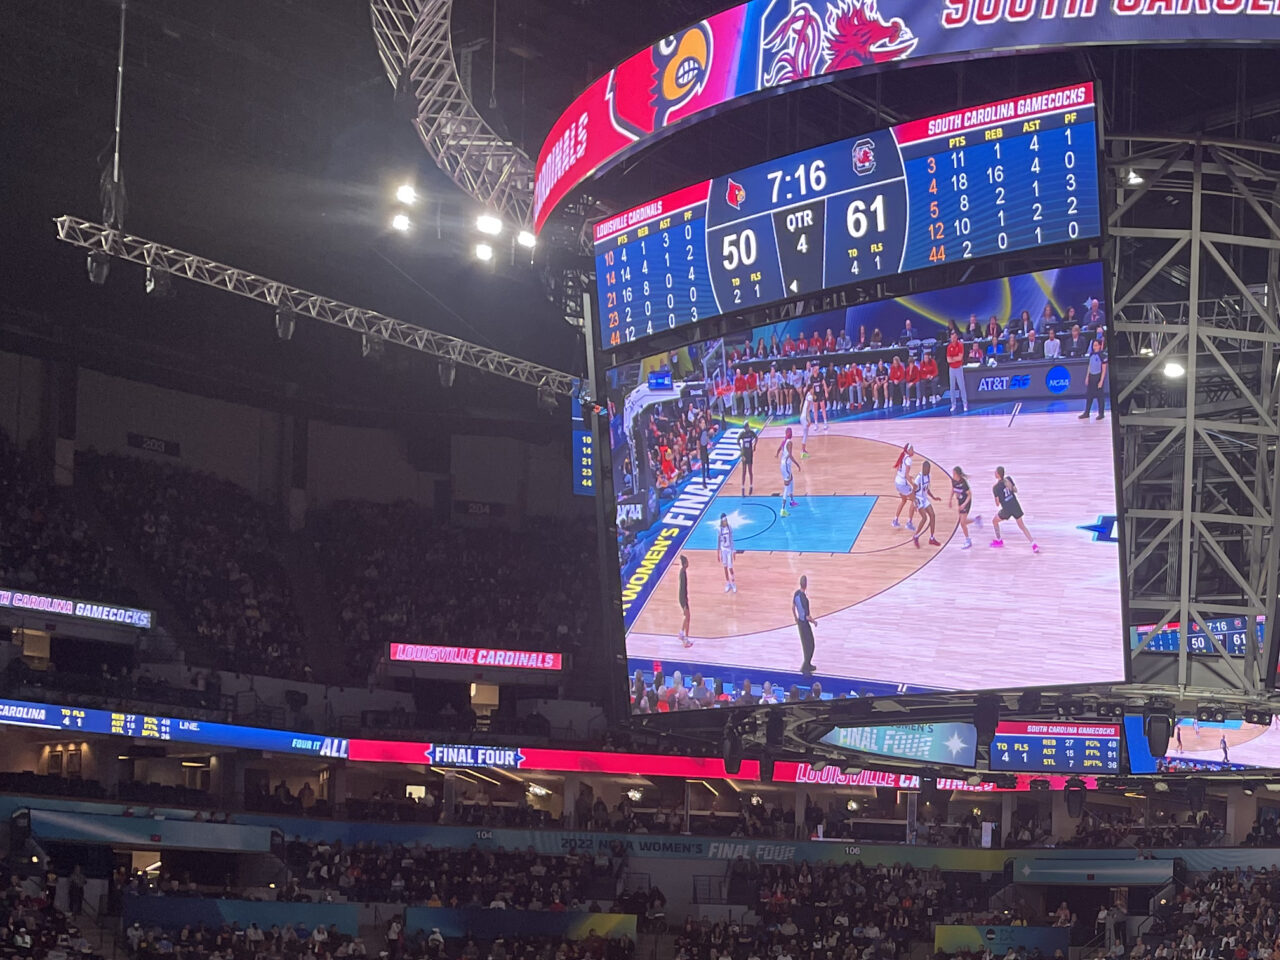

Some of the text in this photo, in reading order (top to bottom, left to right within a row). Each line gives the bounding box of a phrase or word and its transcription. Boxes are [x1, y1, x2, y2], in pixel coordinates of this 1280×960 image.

[927, 87, 1086, 135] SOUTH CAROLINA GAMECOCKS
[949, 113, 1077, 148] PTS REB AST PF
[927, 128, 1072, 174] 3 11 1 4 1
[767, 159, 827, 203] 7:16
[928, 151, 1074, 195] 4 18 16 4 0
[929, 174, 1076, 218] 5 8 2 1 3
[596, 201, 663, 238] LOUISVILLE CARDINALS
[617, 234, 628, 246] PTS
[659, 217, 671, 230] AST
[684, 210, 693, 221] PF
[786, 209, 813, 233] QTR
[846, 195, 886, 238] 61
[928, 197, 1077, 240] 12 10 1 2 2
[605, 225, 692, 267] 10 4 1 3 0
[722, 229, 757, 271] 50
[796, 234, 808, 253] 4
[848, 243, 883, 257] TO FLS
[929, 221, 1078, 263] 44 2 0 1 0
[605, 245, 693, 287] 14 14 4 1 2
[732, 272, 761, 286] TO FLS
[851, 255, 881, 275] 4 1
[607, 266, 695, 308] 21 16 8 0 4
[733, 284, 760, 304] 2 1
[608, 286, 697, 328] 23 2 0 0 0
[610, 306, 698, 346] 44 12 4 0 3
[978, 377, 1009, 391] AT&T
[75, 603, 149, 626] GAMECOCKS
[396, 644, 553, 668] LOUISVILLE CARDINALS
[320, 737, 348, 758] ALL
[434, 746, 515, 765] FINAL FOUR
[882, 729, 933, 757] FOUR
[996, 742, 1029, 751] TO FLS
